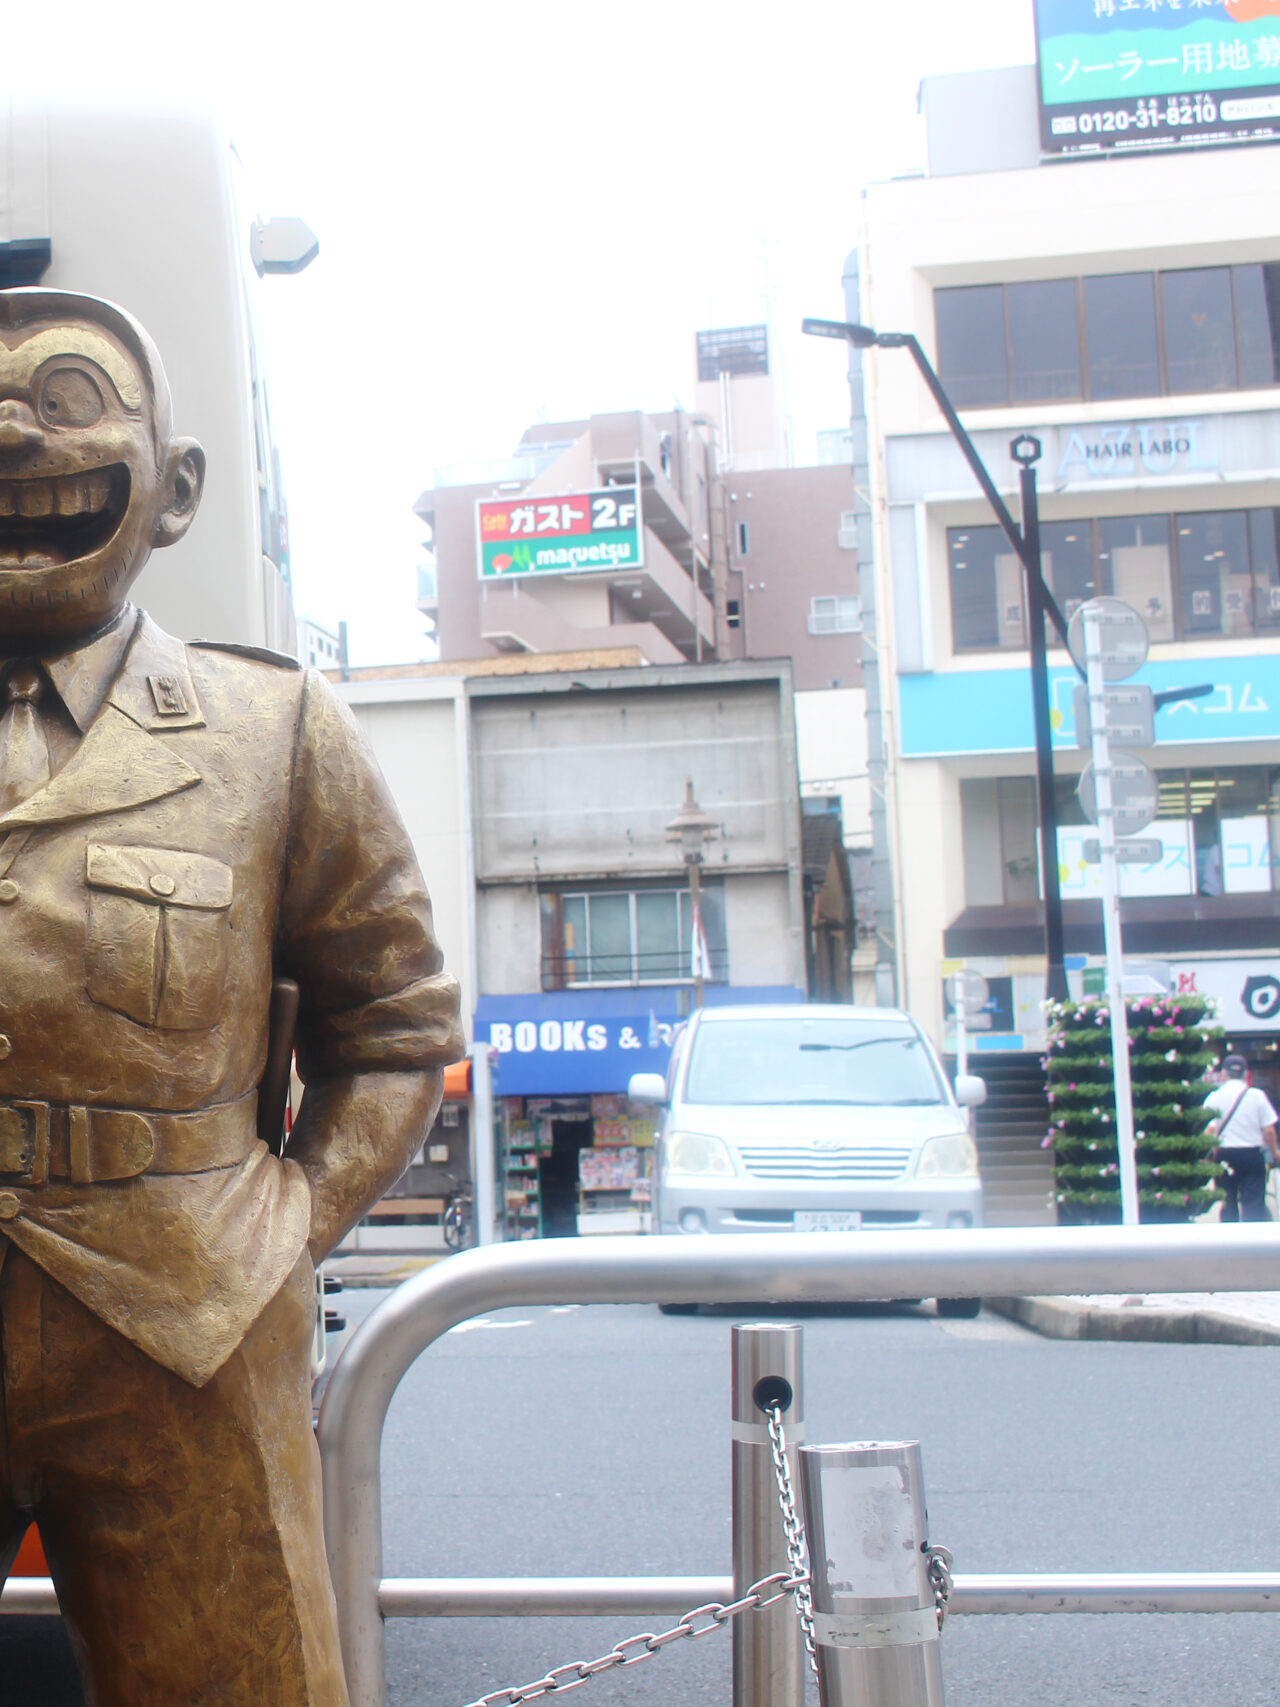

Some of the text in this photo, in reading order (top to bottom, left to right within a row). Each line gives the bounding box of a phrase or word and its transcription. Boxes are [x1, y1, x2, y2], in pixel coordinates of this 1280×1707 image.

[1078, 104, 1216, 133] 0120-31-8210
[1056, 421, 1220, 478] AZUL
[1086, 438, 1190, 458] HAIR LABO
[509, 504, 584, 534] ガスト
[592, 498, 636, 529] 2F
[536, 541, 630, 566] maruetsu
[490, 1020, 608, 1053] BOOKS
[619, 1027, 641, 1049] &
